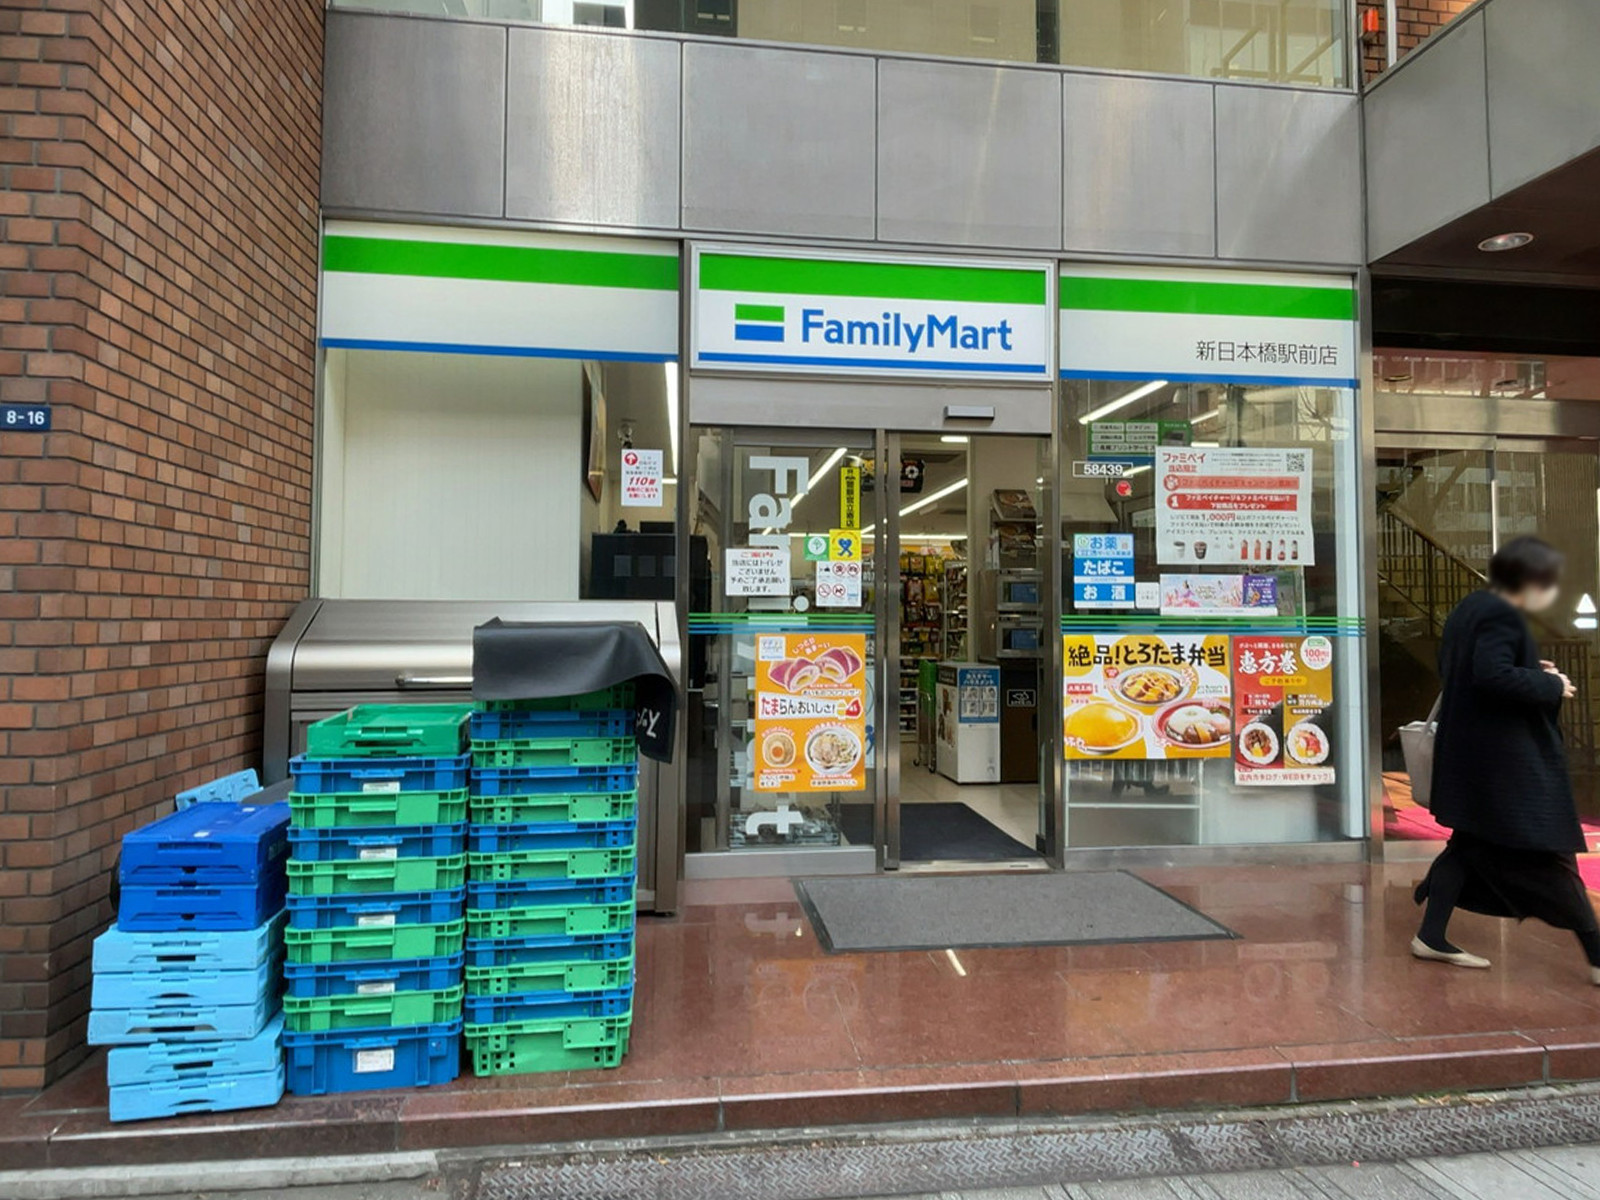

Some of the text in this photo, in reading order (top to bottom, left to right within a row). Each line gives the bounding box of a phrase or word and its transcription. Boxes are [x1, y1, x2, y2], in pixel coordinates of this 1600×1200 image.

[801, 308, 1013, 354] FamilyMart
[1195, 340, 1338, 367] 新日本橋駅前店
[6, 410, 45, 425] 8-16
[1083, 464, 1123, 475] 58439
[1090, 536, 1118, 550] お薬
[1083, 559, 1125, 575] たばこ
[1083, 583, 1126, 601] お酒
[1068, 642, 1226, 667] 絶品!とろたま弁当
[1238, 649, 1298, 675] 恵方巻
[761, 697, 835, 716] たまらんおいしさ!
